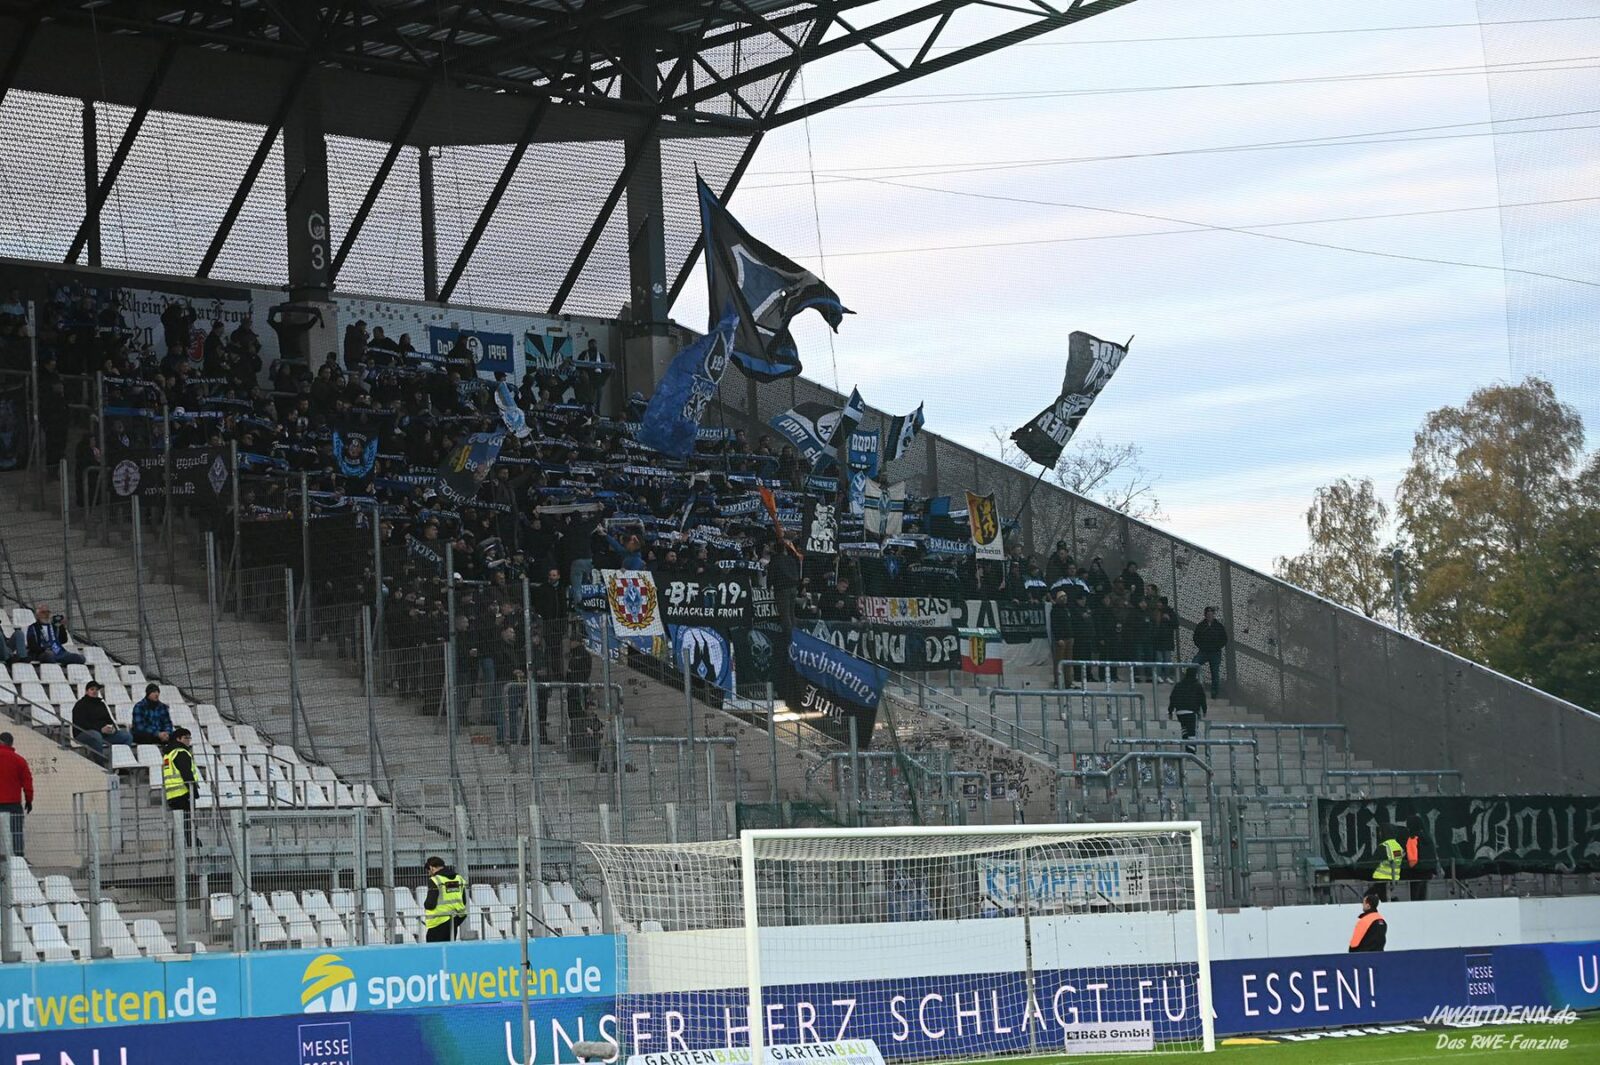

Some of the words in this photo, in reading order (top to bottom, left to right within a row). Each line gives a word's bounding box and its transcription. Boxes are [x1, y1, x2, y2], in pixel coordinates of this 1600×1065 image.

[311, 243, 325, 270] 3
[696, 427, 728, 440] ARACKLER
[763, 511, 803, 522] BAACKLER
[666, 606, 715, 617] BARACKLER
[717, 607, 744, 618] FRONT
[788, 641, 877, 704] Cuxhavener
[1467, 966, 1494, 979] MESSE
[368, 957, 601, 1008] sportwetten.de
[1469, 982, 1495, 996] ESSEN
[505, 1011, 689, 1065] UNSER
[725, 998, 857, 1048] HERZ
[890, 977, 1108, 1042] SCHLÄGT
[1242, 967, 1376, 1016] ESSEN!
[1081, 1030, 1107, 1040] B&B
[1109, 1028, 1150, 1039] GmbH
[302, 1038, 349, 1057] MESSE
[645, 1047, 751, 1065] GARTENBAU
[770, 1041, 868, 1060] GARTENBAU
